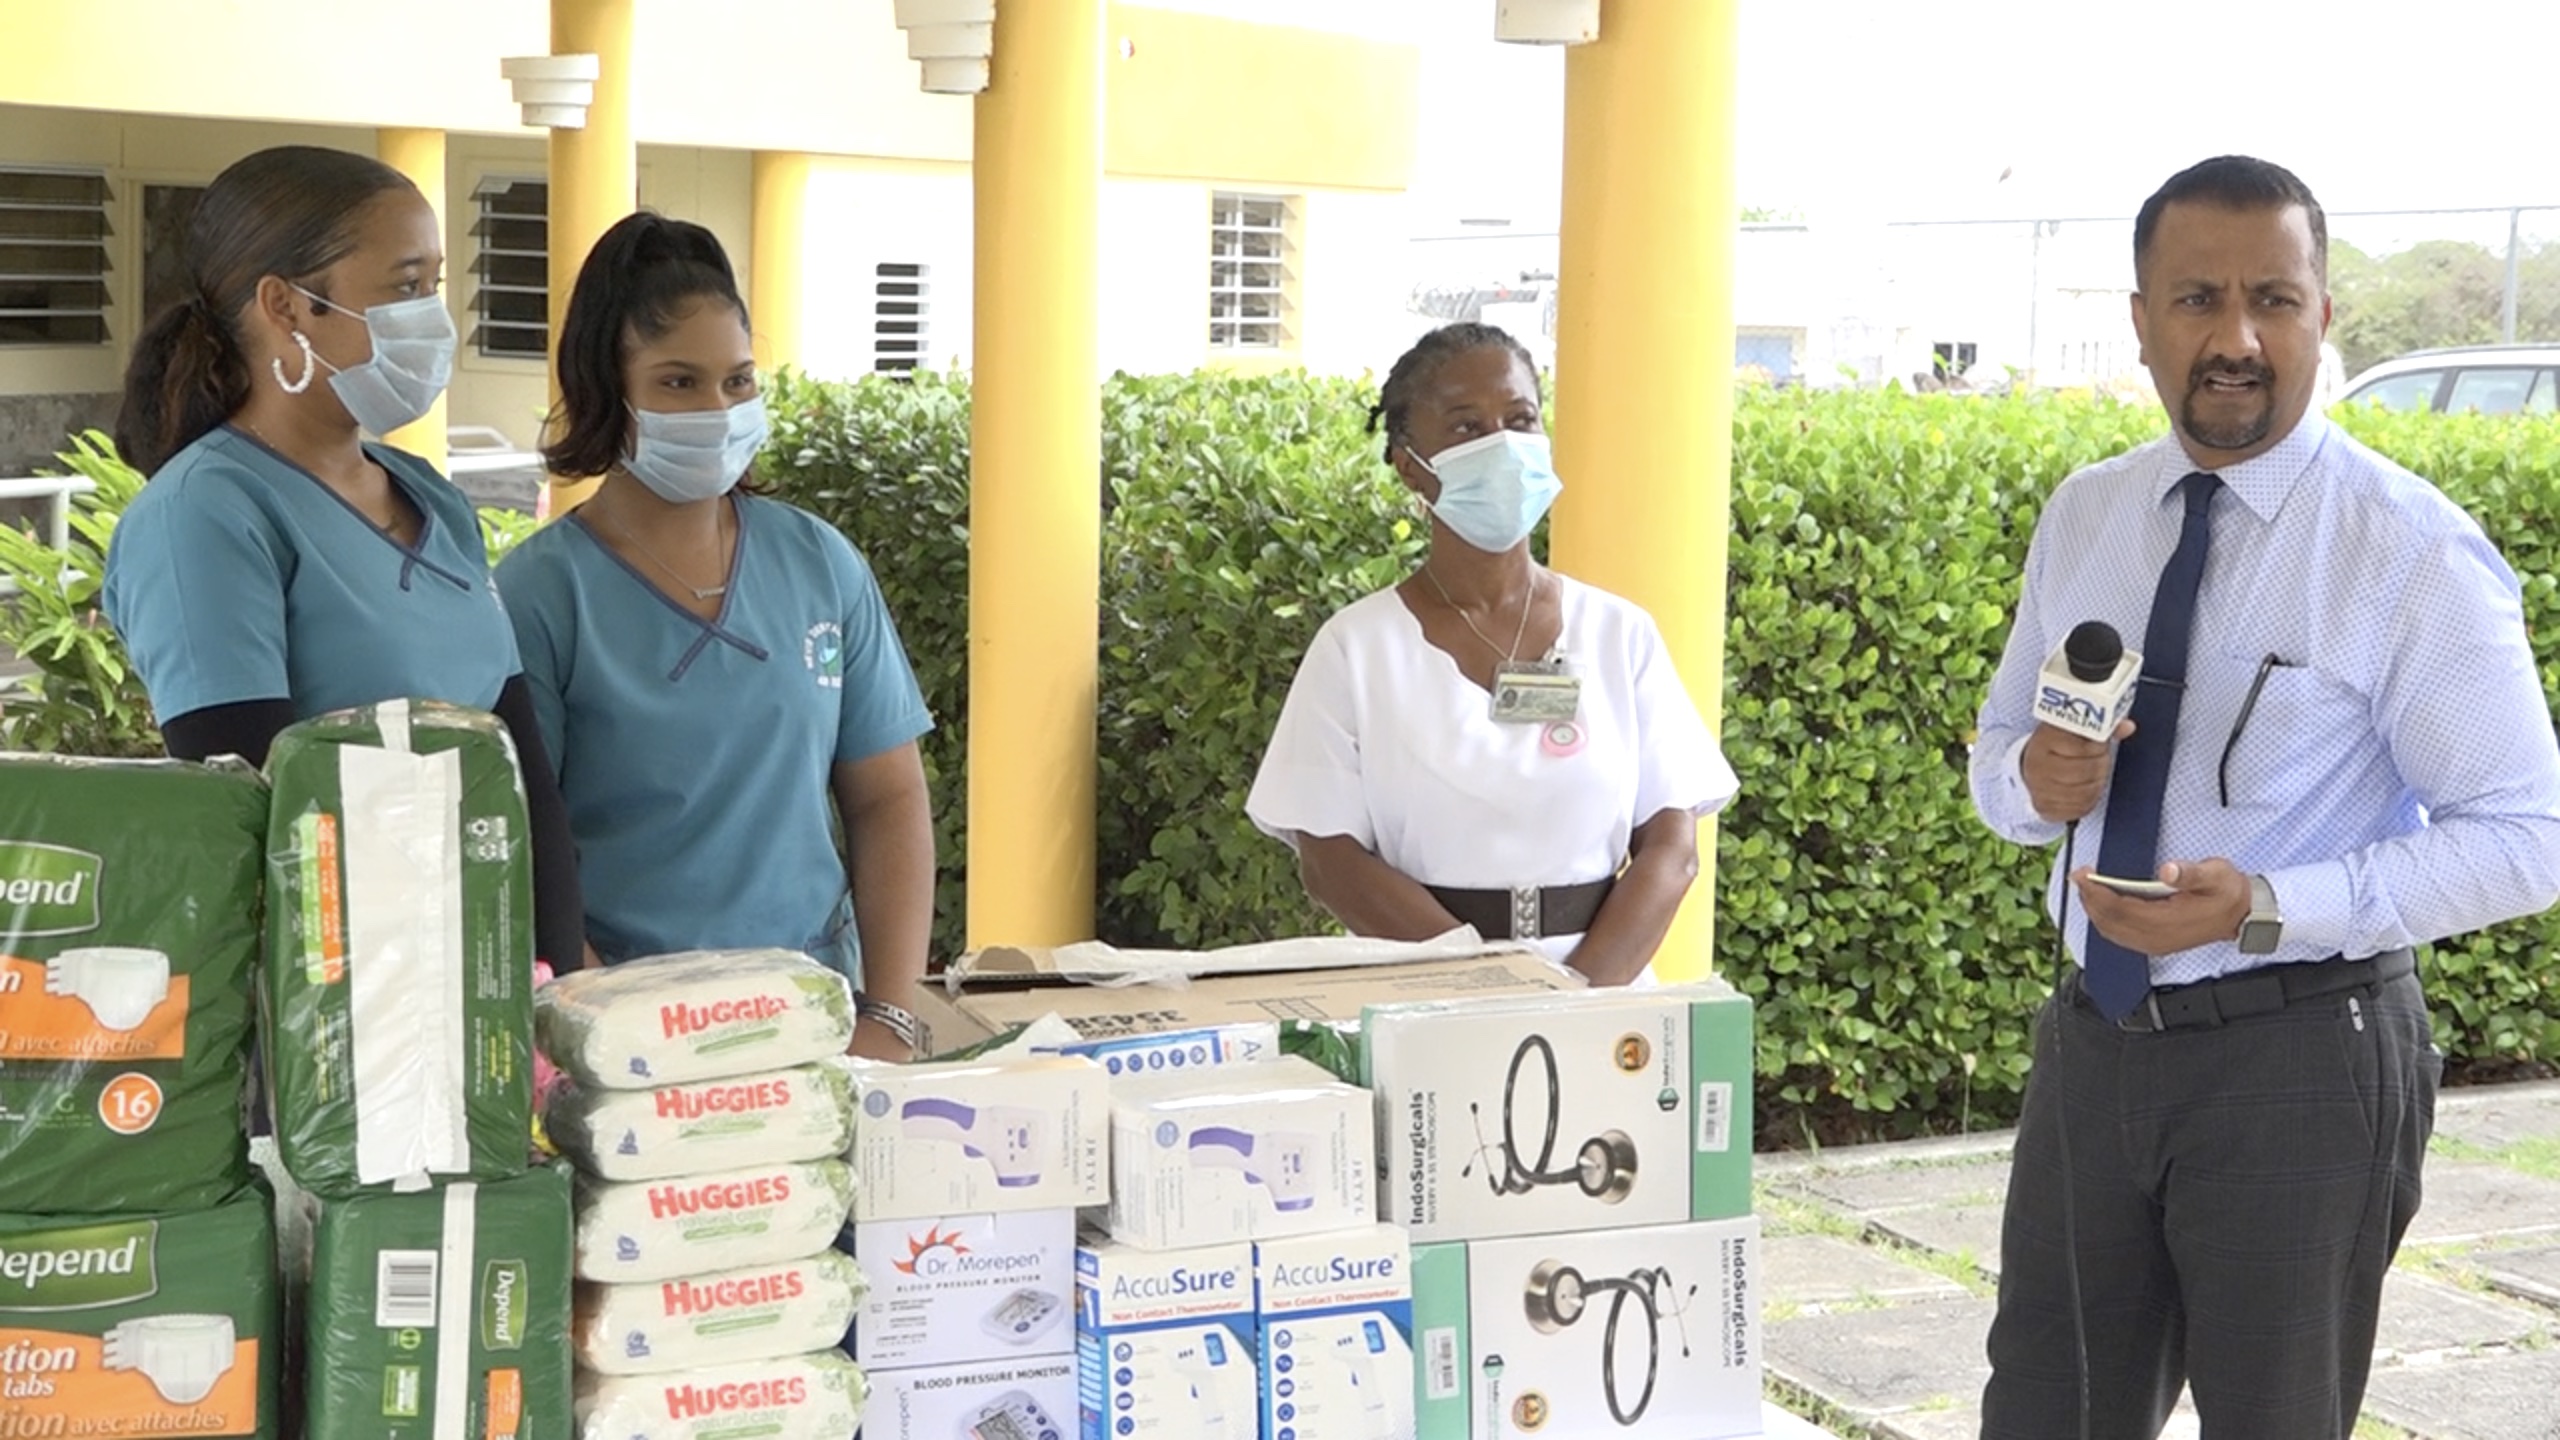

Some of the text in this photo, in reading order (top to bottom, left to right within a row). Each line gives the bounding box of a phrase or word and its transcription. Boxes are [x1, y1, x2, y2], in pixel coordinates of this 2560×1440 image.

[2042, 686, 2105, 723] SKN
[111, 1089, 153, 1119] 16
[655, 1080, 791, 1118] HUGGIES
[1409, 1092, 1427, 1225] IndoSurgicals
[648, 1176, 790, 1218] HUGGIES
[956, 1252, 1041, 1274] Morepen
[1272, 1255, 1394, 1288] AccuSure
[662, 1271, 804, 1315] HUGGIES
[936, 1278, 989, 1289] PRESSURE
[993, 1273, 1042, 1285] MONITOR
[1112, 1268, 1236, 1300] AccuSure
[1294, 1295, 1332, 1306] Contact
[1335, 1289, 1399, 1301] Thermometer
[491, 1269, 516, 1343] Depend
[1135, 1307, 1173, 1319] Contact
[1176, 1301, 1242, 1313] Thermometer
[1731, 1237, 1748, 1367] IndoSurgicals
[0, 1339, 76, 1374] tion
[3, 1372, 55, 1397] tabs
[913, 1365, 1072, 1390] BLOOD PRESSURE MONITOR
[664, 1377, 807, 1419] HUGGIES
[70, 1416, 125, 1434] avec
[130, 1407, 226, 1431] attaches
